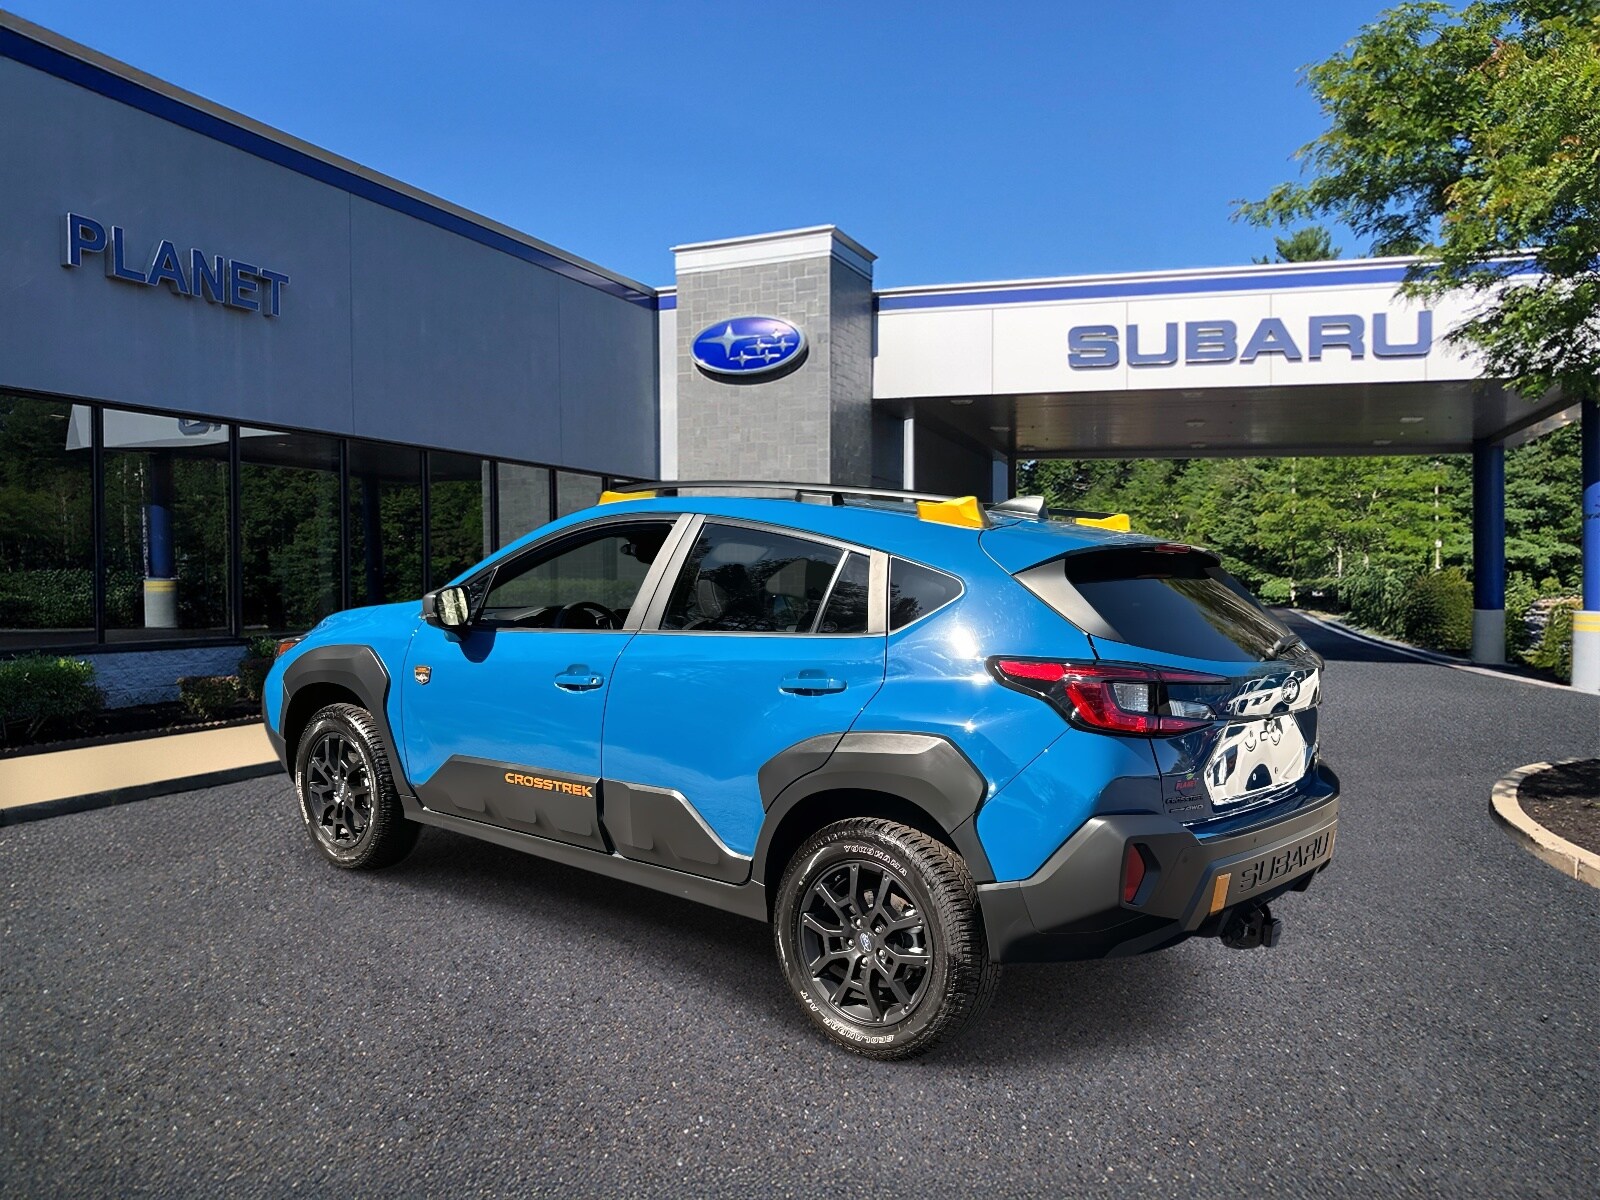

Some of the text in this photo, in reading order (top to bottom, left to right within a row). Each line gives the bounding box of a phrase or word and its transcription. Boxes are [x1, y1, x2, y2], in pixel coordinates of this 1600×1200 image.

[62, 212, 290, 317] PLANET
[1068, 310, 1433, 370] SUBARU
[504, 772, 594, 798] CROSSTREK
[843, 844, 908, 877] YOKOHAMA
[1239, 831, 1330, 893] SUBARU
